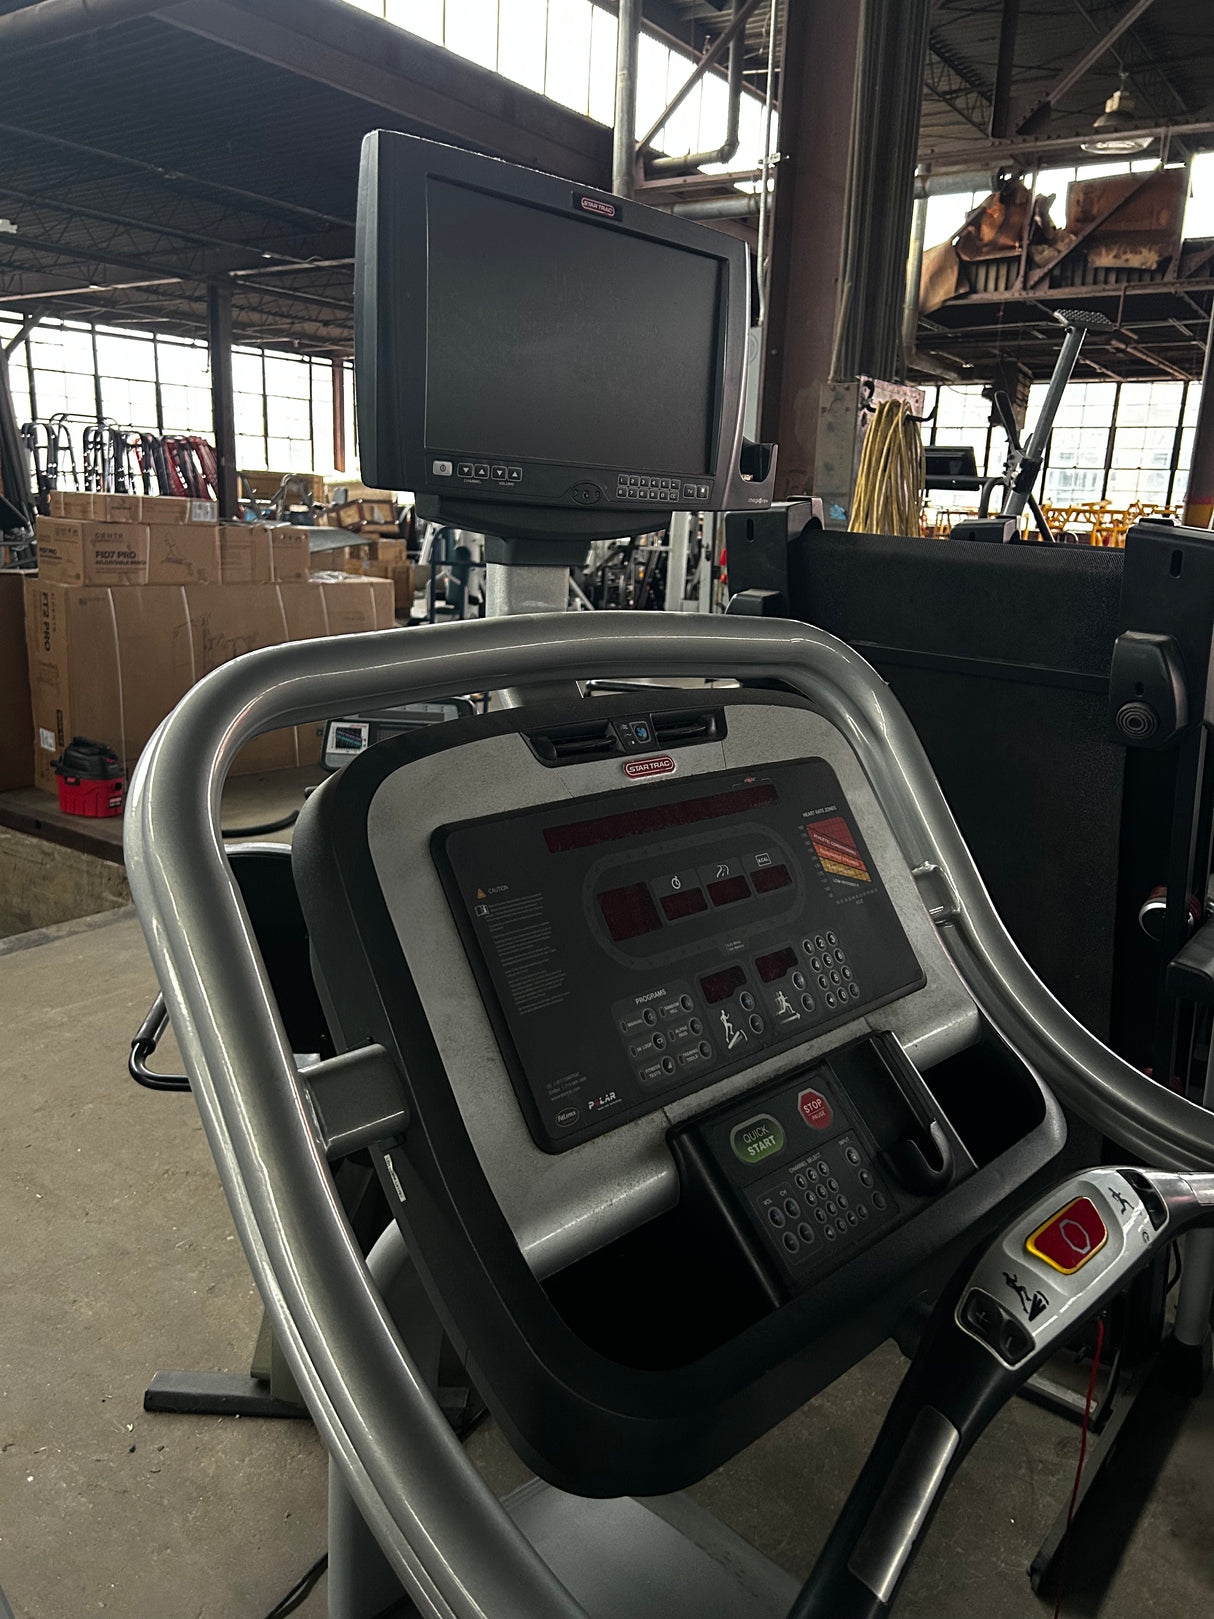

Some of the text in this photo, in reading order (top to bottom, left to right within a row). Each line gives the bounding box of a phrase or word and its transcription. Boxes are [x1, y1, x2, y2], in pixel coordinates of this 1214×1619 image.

[583, 200, 613, 214] STAR TRAC
[117, 551, 136, 559] PRO
[41, 592, 51, 652] FT2 PRO
[629, 760, 670, 772] STAR TRAC
[635, 988, 667, 1006] PROGRAMS
[588, 1091, 616, 1110] POLAR
[803, 1098, 822, 1114] STOP
[811, 1110, 826, 1121] PAUSE
[742, 1124, 770, 1144] QUICK
[746, 1135, 776, 1157] START
[788, 1161, 807, 1175] CHANNEL
